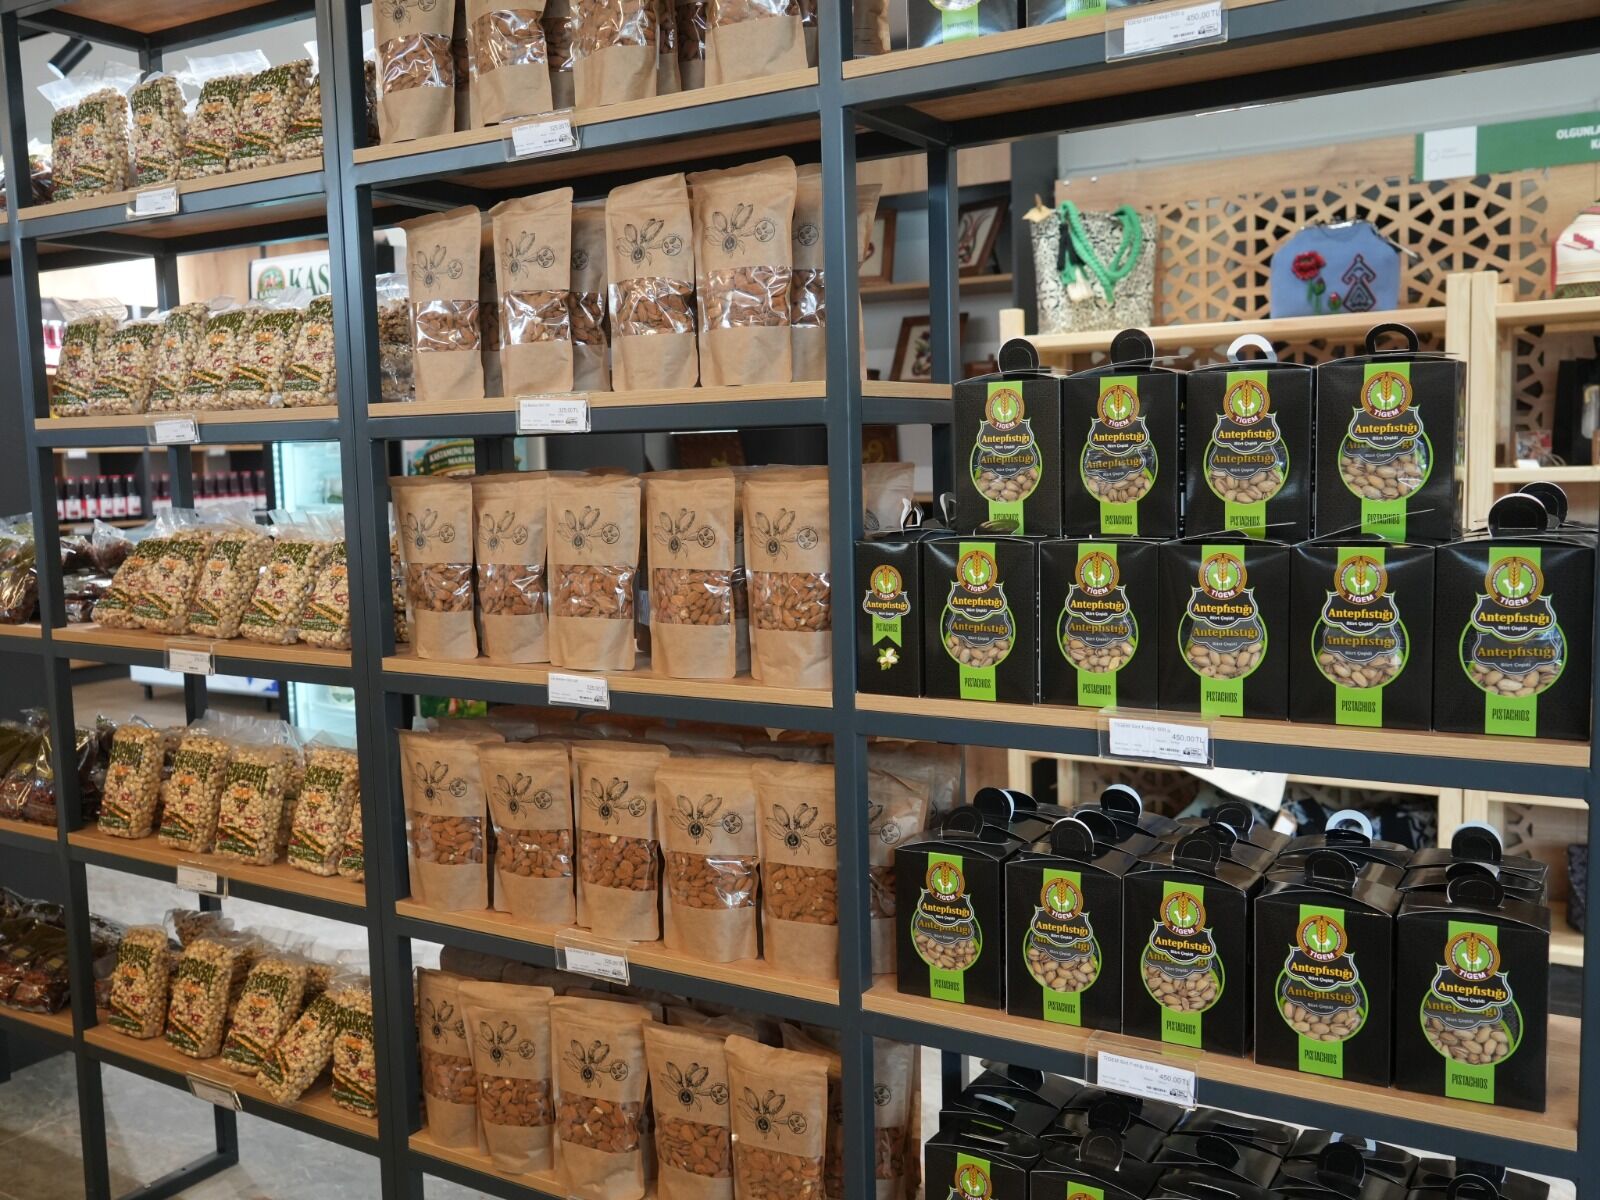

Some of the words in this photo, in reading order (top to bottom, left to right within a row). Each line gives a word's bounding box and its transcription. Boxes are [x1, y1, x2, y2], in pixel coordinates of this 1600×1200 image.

[1218, 429, 1275, 441] Antepfıstığı
[1355, 424, 1418, 435] Antepfıstığı
[981, 433, 1029, 444] Antepfıstığı
[1093, 432, 1144, 442] Antepfıstığı
[1105, 515, 1132, 525] PISTACHIOS
[866, 601, 907, 611] Antepfıstığı
[952, 597, 1002, 608] Antepfıstığı
[1071, 600, 1125, 612] Antepfıstığı
[1500, 596, 1529, 607] TİGEM
[1193, 603, 1252, 616] Antepfıstığı
[1328, 608, 1393, 622] Antepfıstığı
[1478, 612, 1550, 625] Antepfıstığı
[965, 677, 991, 688] PISTACHIOS
[1083, 684, 1111, 696] PISTACHIOS
[1206, 691, 1237, 703] PISTACHIOS
[1341, 700, 1376, 713] PISTACHIOS
[1492, 708, 1530, 722] PISTACHIOS
[922, 903, 969, 918] Antepfıstığı
[1036, 921, 1089, 937] Antepfıstığı
[1155, 936, 1210, 953] Antepfıstığı
[1291, 962, 1352, 980] Antepfıstığı
[1438, 982, 1506, 1000] Antepfıstığı
[1166, 1020, 1196, 1035] PISTACHIOS
[1304, 1050, 1337, 1065] PISTACHIOS
[1452, 1074, 1488, 1089] PISTACHIOS
